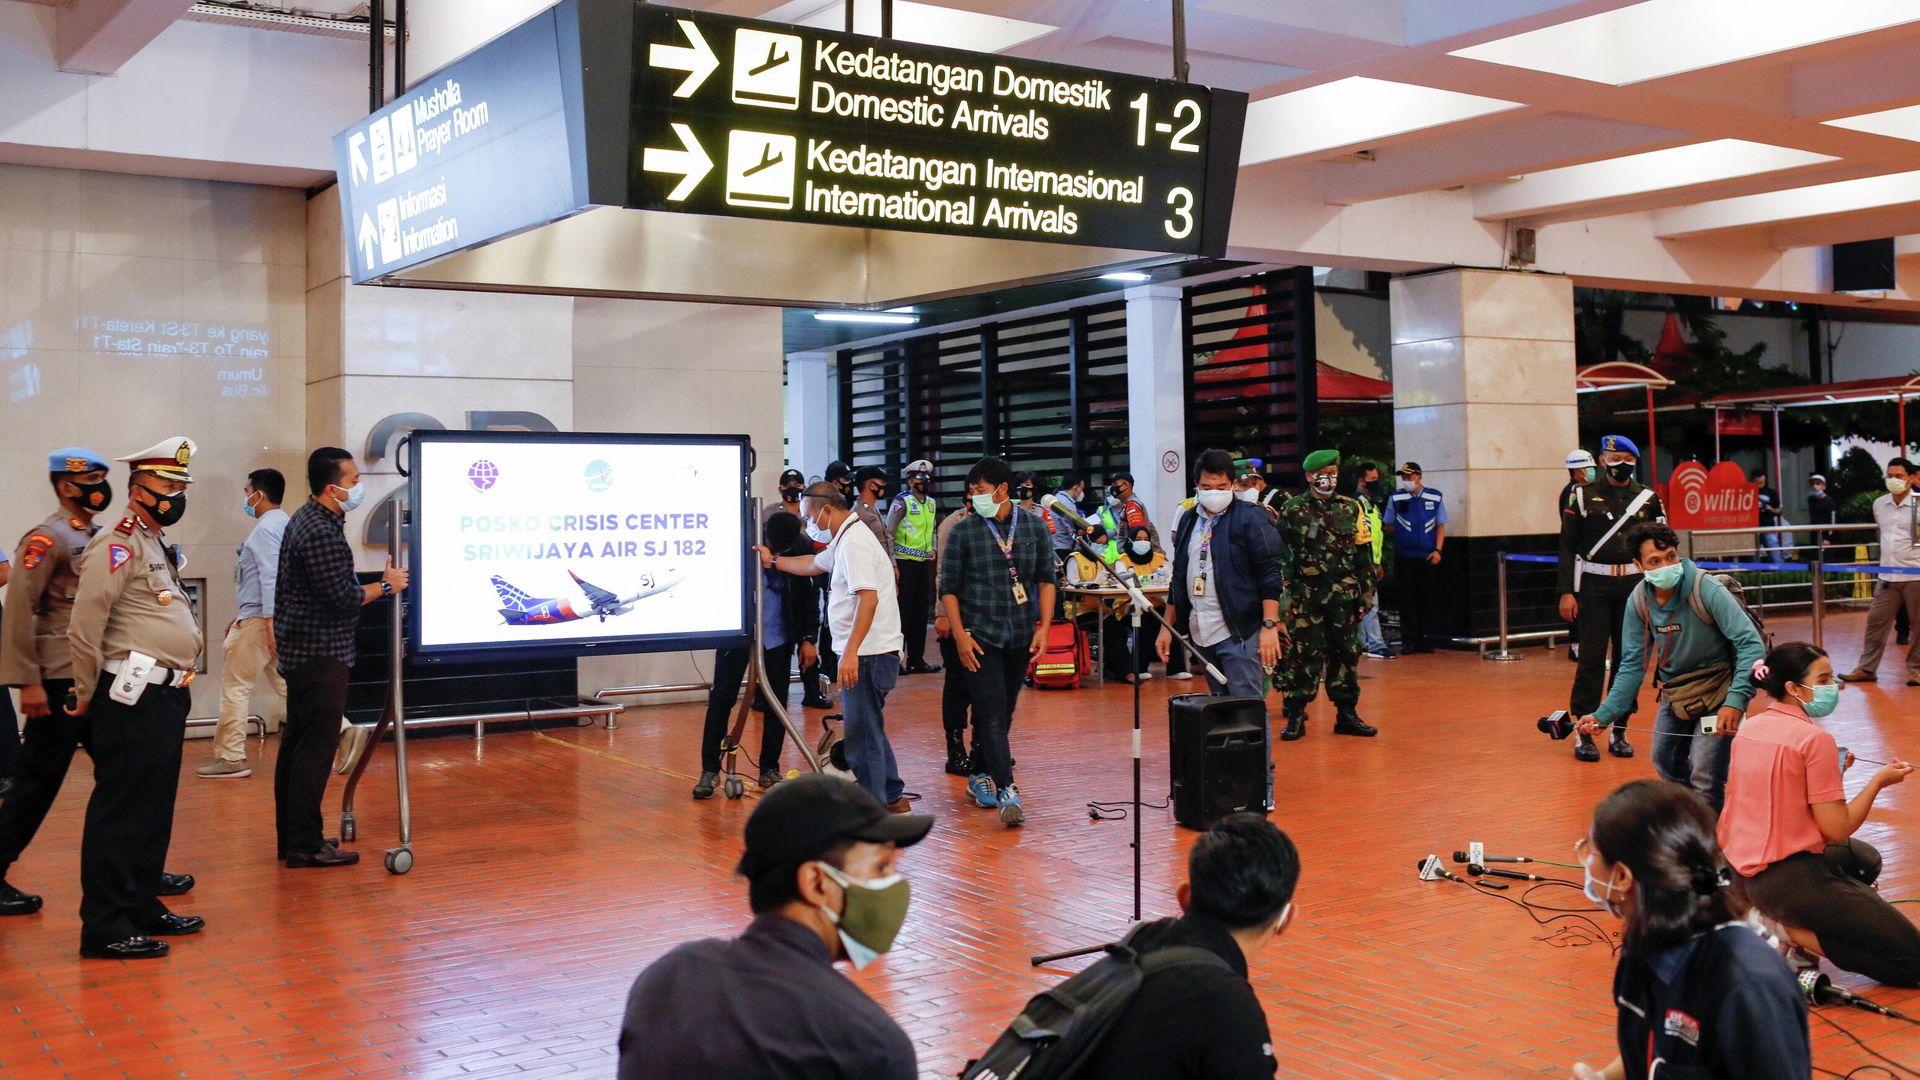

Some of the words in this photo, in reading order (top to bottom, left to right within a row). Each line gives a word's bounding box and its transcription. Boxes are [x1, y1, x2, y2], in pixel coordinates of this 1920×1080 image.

[413, 79, 462, 125] Musholla
[813, 41, 984, 96] Kedatangan
[992, 64, 1112, 112] Domestik
[416, 118, 452, 156] Prayer
[453, 101, 489, 138] Room
[810, 82, 945, 129] Domestic
[951, 105, 1050, 142] Arrivals
[1129, 91, 1203, 154] 1-2
[399, 176, 448, 221] Informasi
[805, 138, 977, 193] Kedatangan
[986, 157, 1143, 204] Internasional
[803, 179, 976, 226] International
[982, 204, 1079, 236] Arrivals
[1164, 185, 1195, 240] 3
[402, 216, 459, 256] Information
[460, 514, 541, 534] POSKO
[549, 513, 619, 532] CRISIS
[625, 513, 710, 530] CENTER
[463, 541, 595, 562] SRIWIJAYA
[601, 540, 638, 559] AIR
[643, 540, 667, 557] SJ
[674, 538, 707, 556] 182
